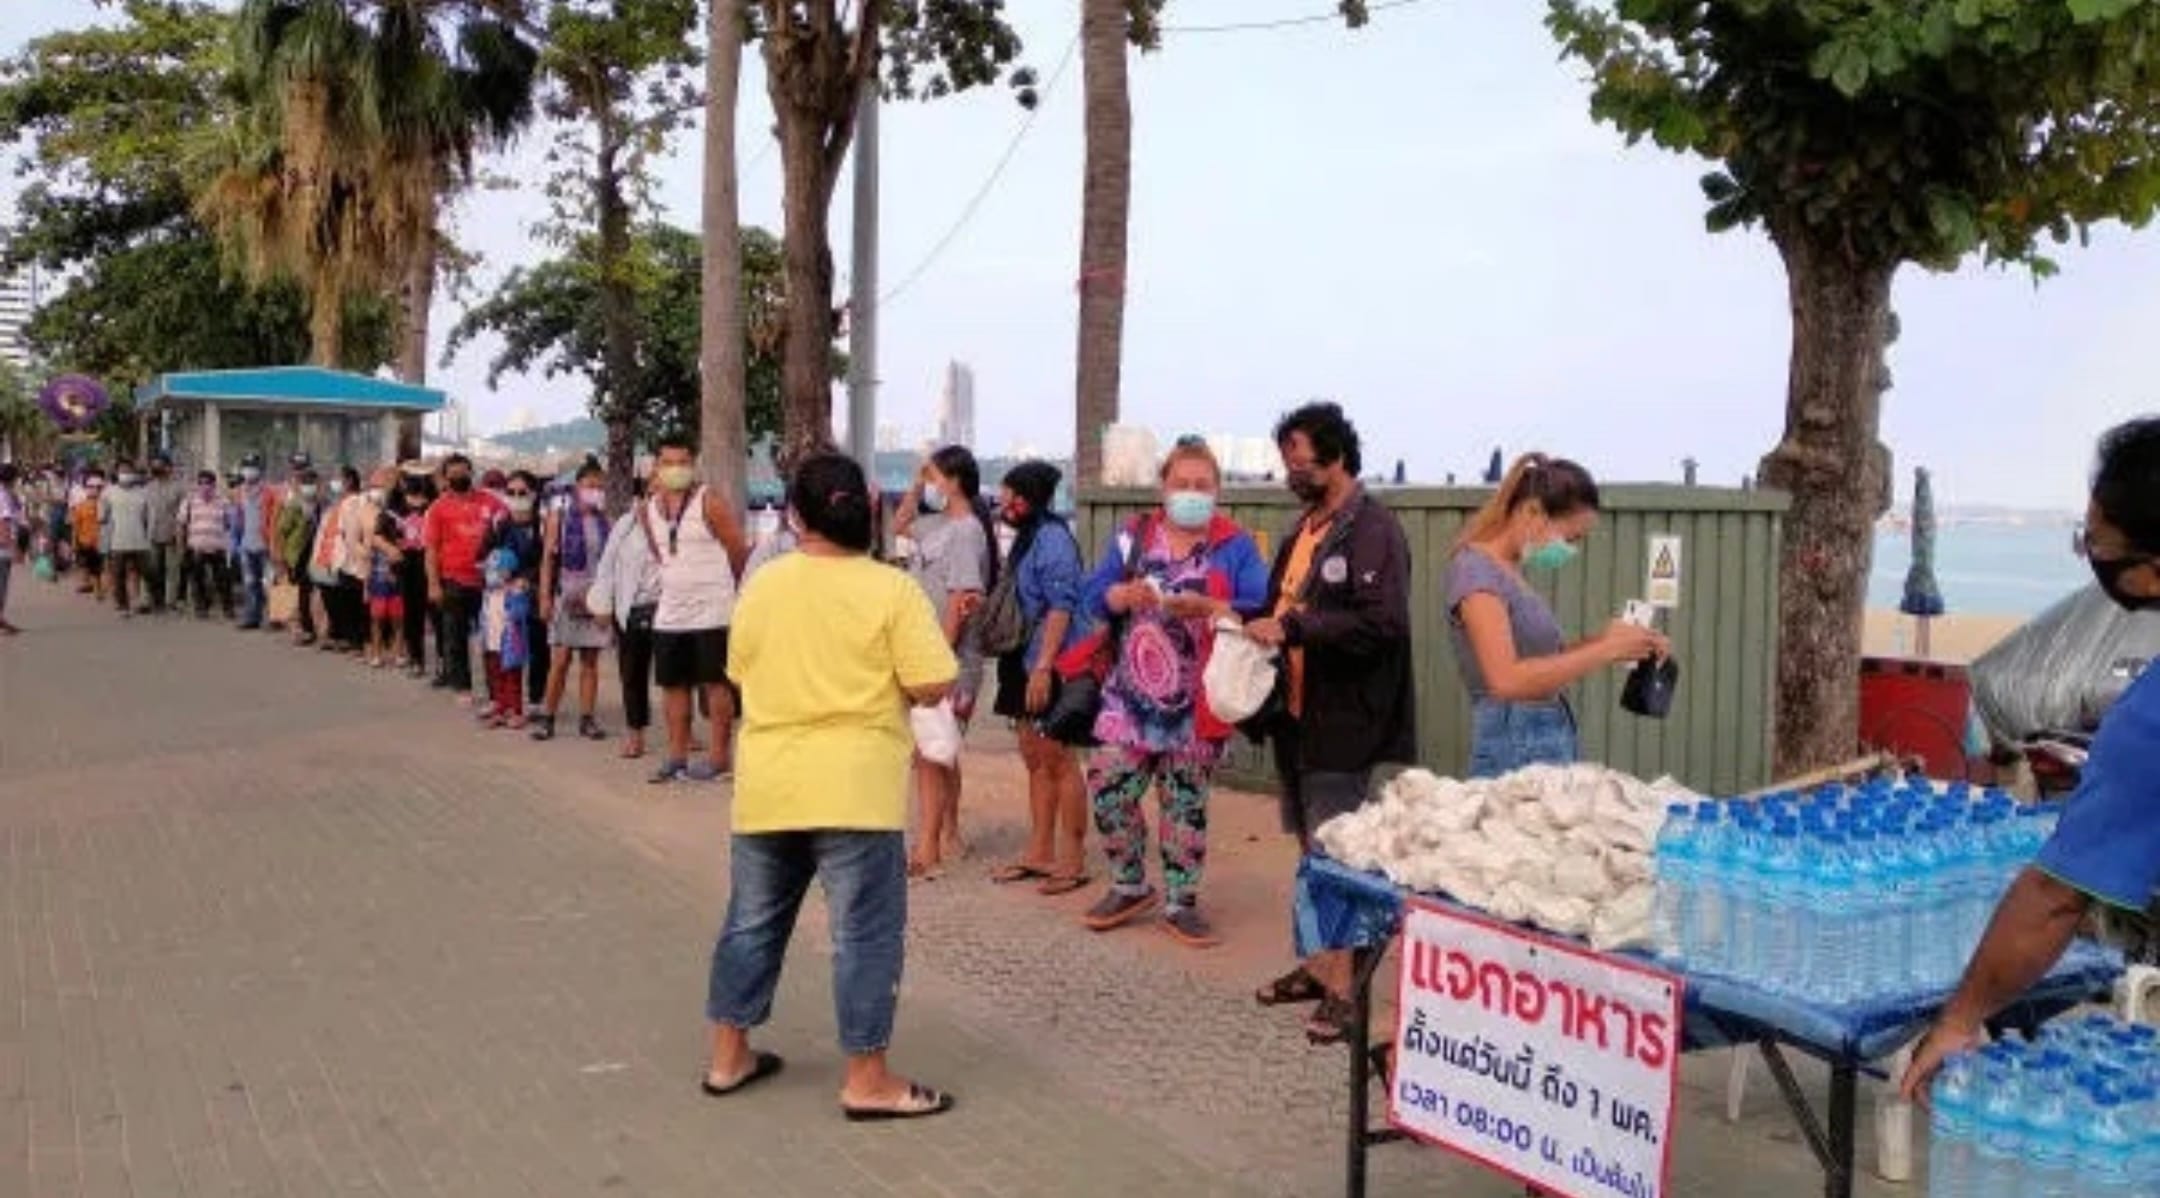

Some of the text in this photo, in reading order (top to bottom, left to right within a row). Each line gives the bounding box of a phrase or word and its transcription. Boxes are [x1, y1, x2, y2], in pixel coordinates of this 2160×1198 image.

[1411, 939, 1667, 1069] แจกอาหาร
[1400, 1082, 1449, 1117] เวลา
[1457, 1101, 1531, 1151] 08:00
[1541, 1135, 1563, 1166] น.
[1404, 1007, 1658, 1144] ตั้งแต่วันนี้ ถึง 1 พค.
